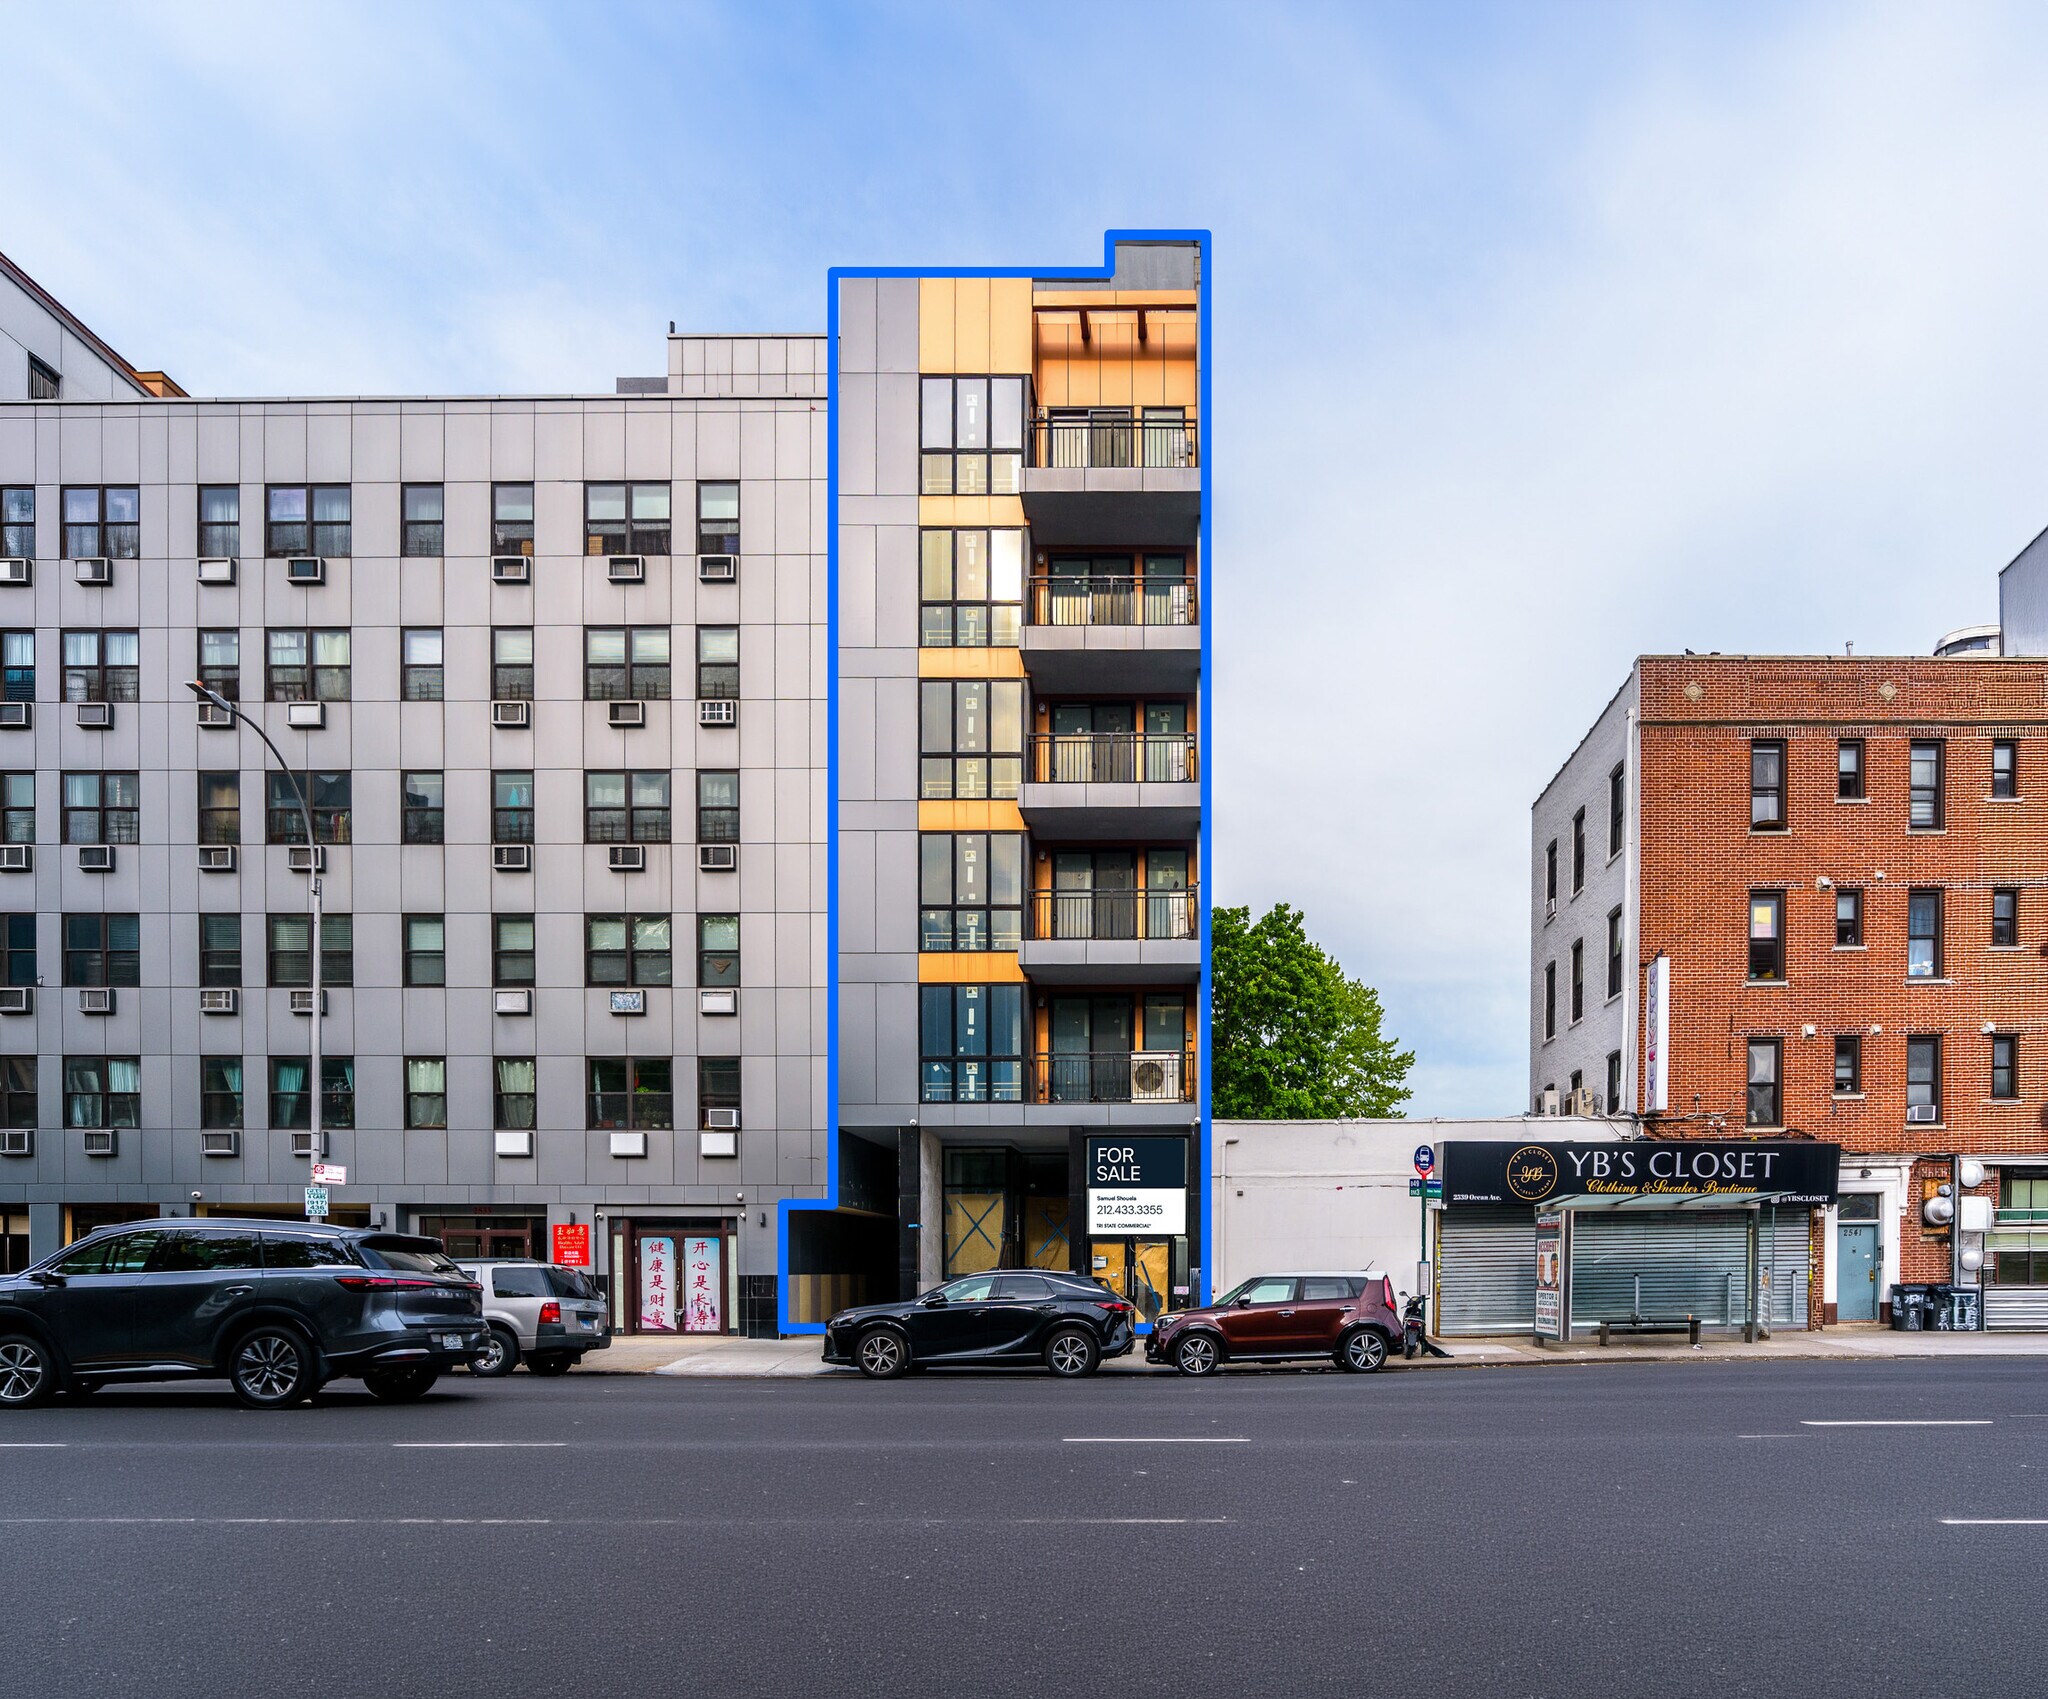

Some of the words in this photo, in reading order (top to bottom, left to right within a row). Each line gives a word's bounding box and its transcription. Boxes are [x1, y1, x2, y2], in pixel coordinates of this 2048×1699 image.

[1647, 1050, 1656, 1106] CITY
[1097, 1147, 1135, 1163] FOR
[1528, 1149, 1552, 1164] CLOSET
[1096, 1165, 1141, 1181] SALE
[1567, 1151, 1636, 1178] YB'S
[1649, 1151, 1780, 1179] CLOSET
[1520, 1165, 1543, 1183] YB
[1586, 1179, 1638, 1194] Clothing
[1701, 1180, 1758, 1194] Boutique
[1781, 1195, 1829, 1203] @YBSCLOSET
[1096, 1205, 1163, 1215] 212.433.3355
[1843, 1229, 1862, 1237] 2541
[648, 1241, 667, 1326] 健康是财富
[692, 1241, 711, 1326] 开心是长寿
